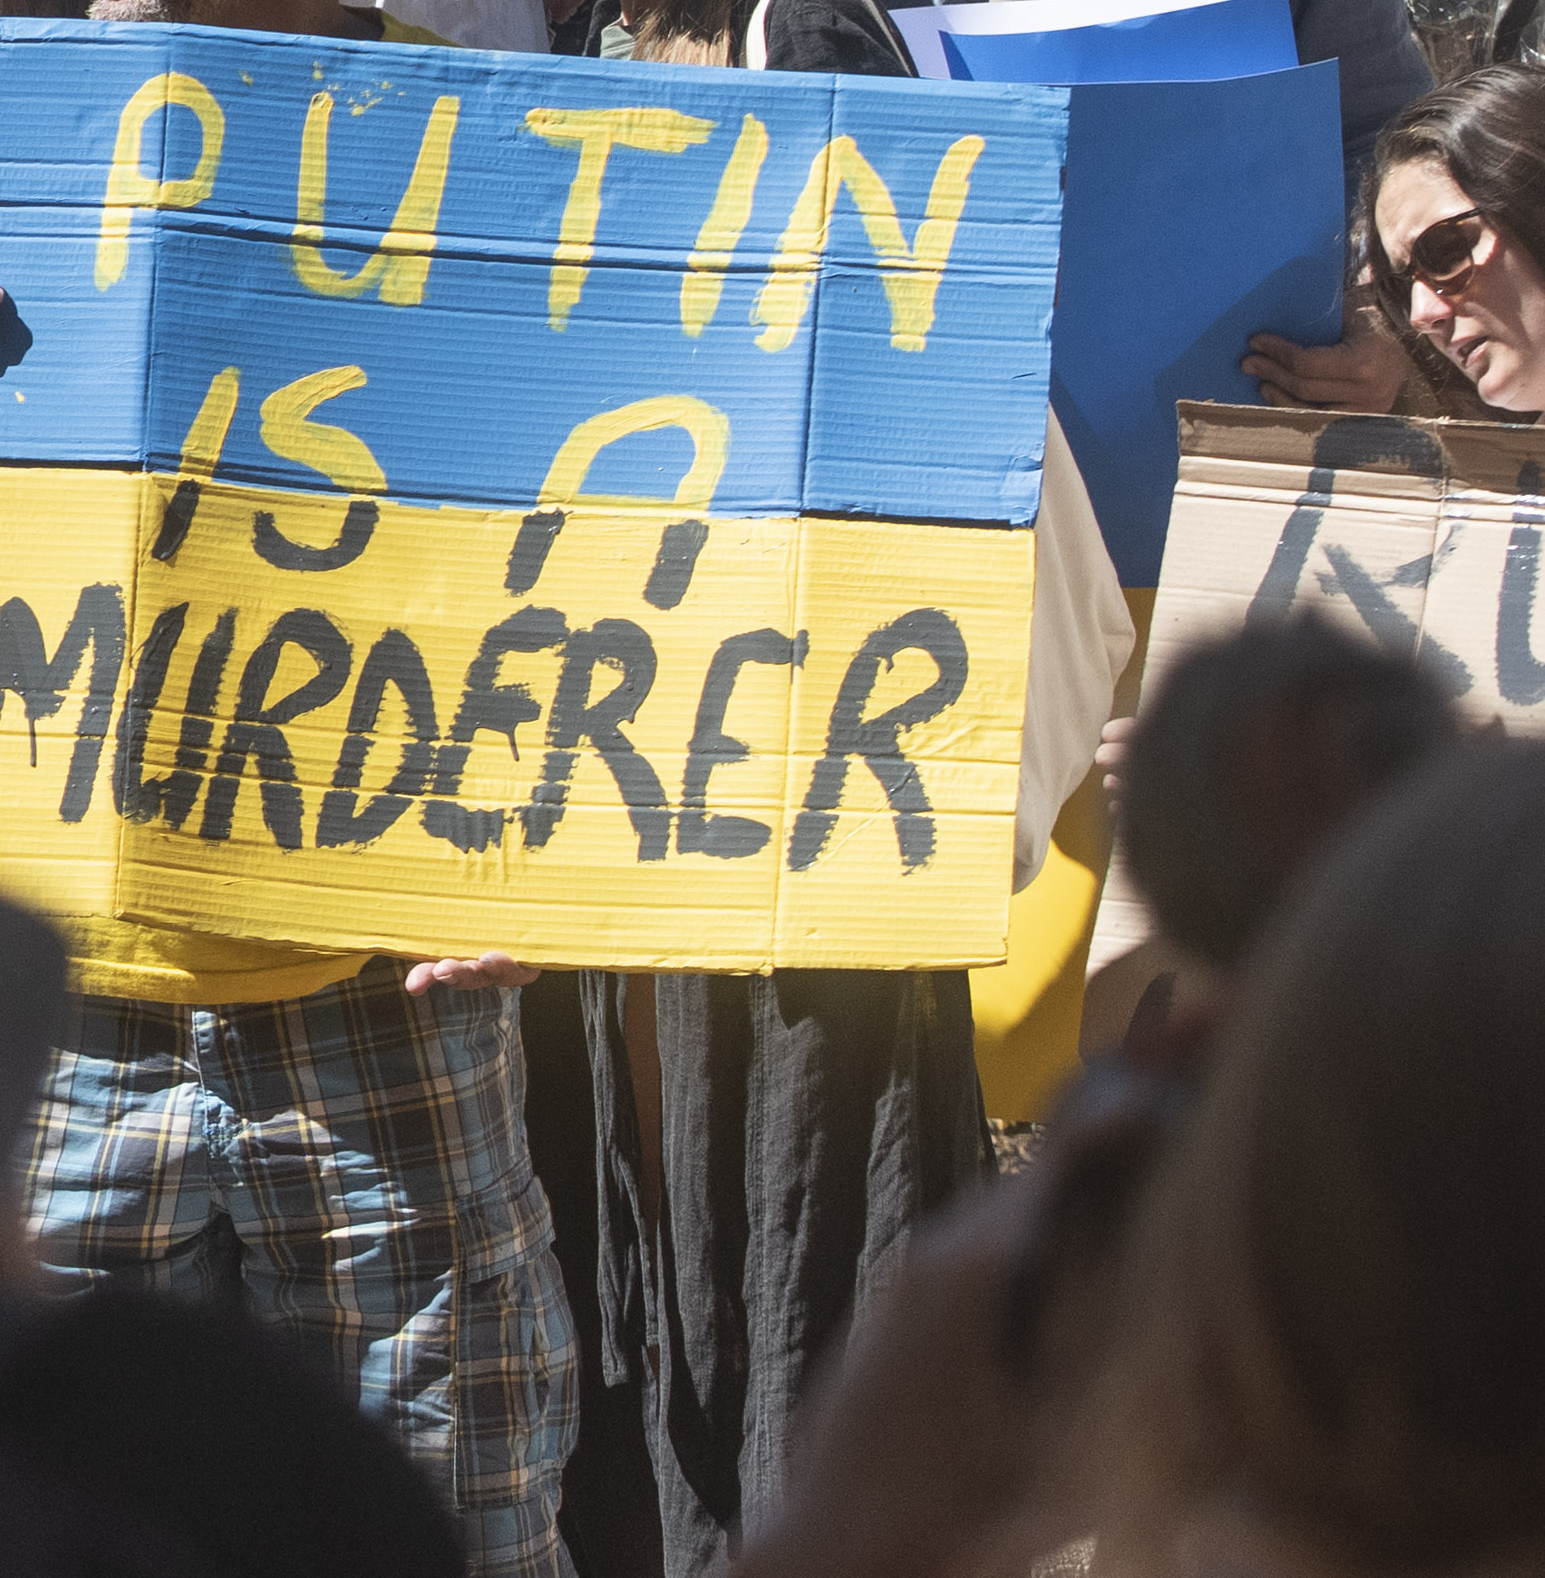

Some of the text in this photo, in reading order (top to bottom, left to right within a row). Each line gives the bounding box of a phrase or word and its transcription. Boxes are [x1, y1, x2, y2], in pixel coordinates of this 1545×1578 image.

[92, 70, 986, 356] PUTIN
[151, 366, 730, 610] IS A
